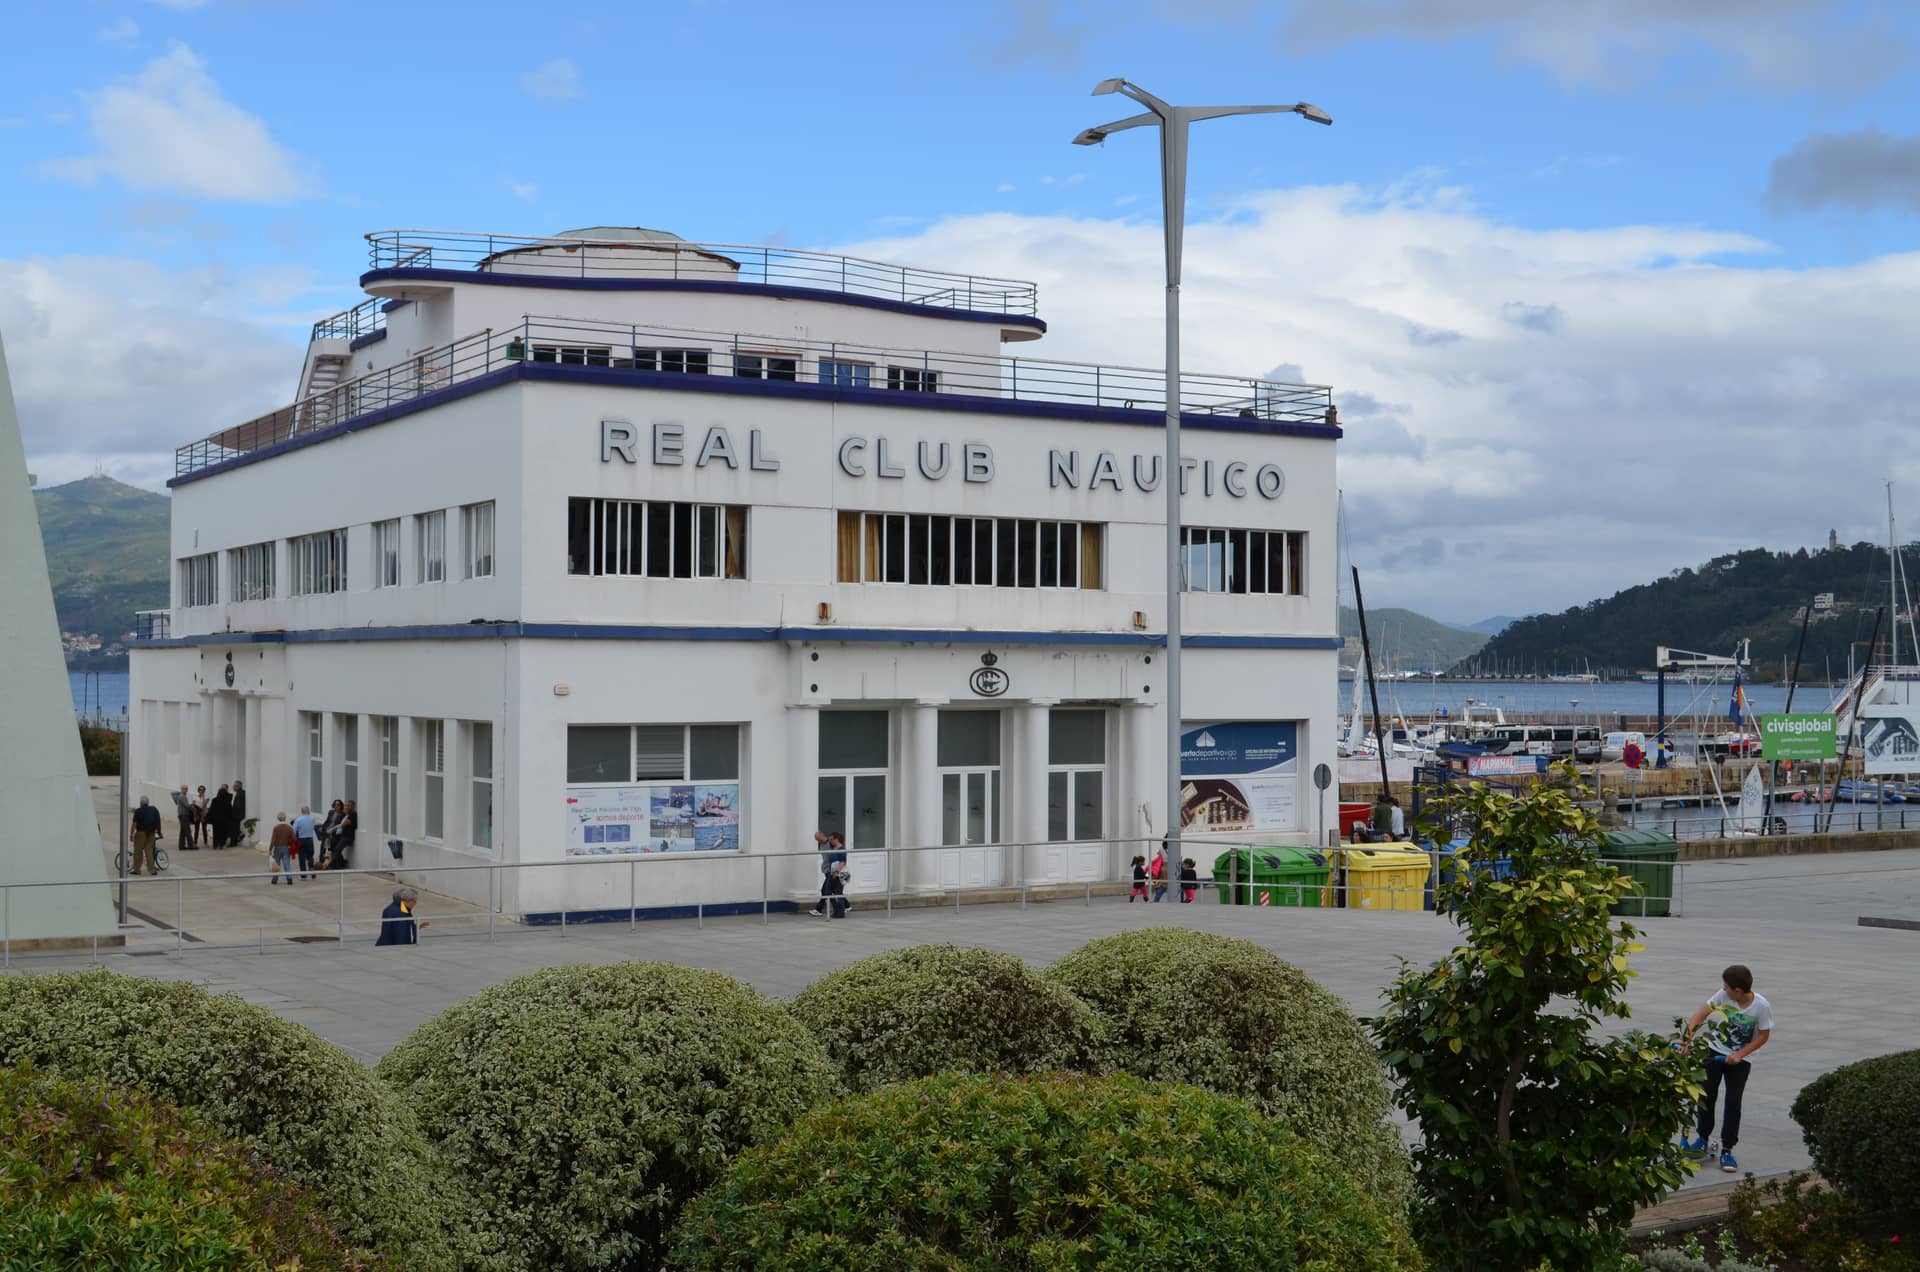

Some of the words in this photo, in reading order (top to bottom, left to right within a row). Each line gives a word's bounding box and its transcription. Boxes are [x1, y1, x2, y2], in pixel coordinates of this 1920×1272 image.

[601, 420, 781, 472] REAL
[838, 437, 996, 484] CLUB
[1049, 449, 1286, 500] NAUTICO
[1767, 718, 1832, 735] civisglobal
